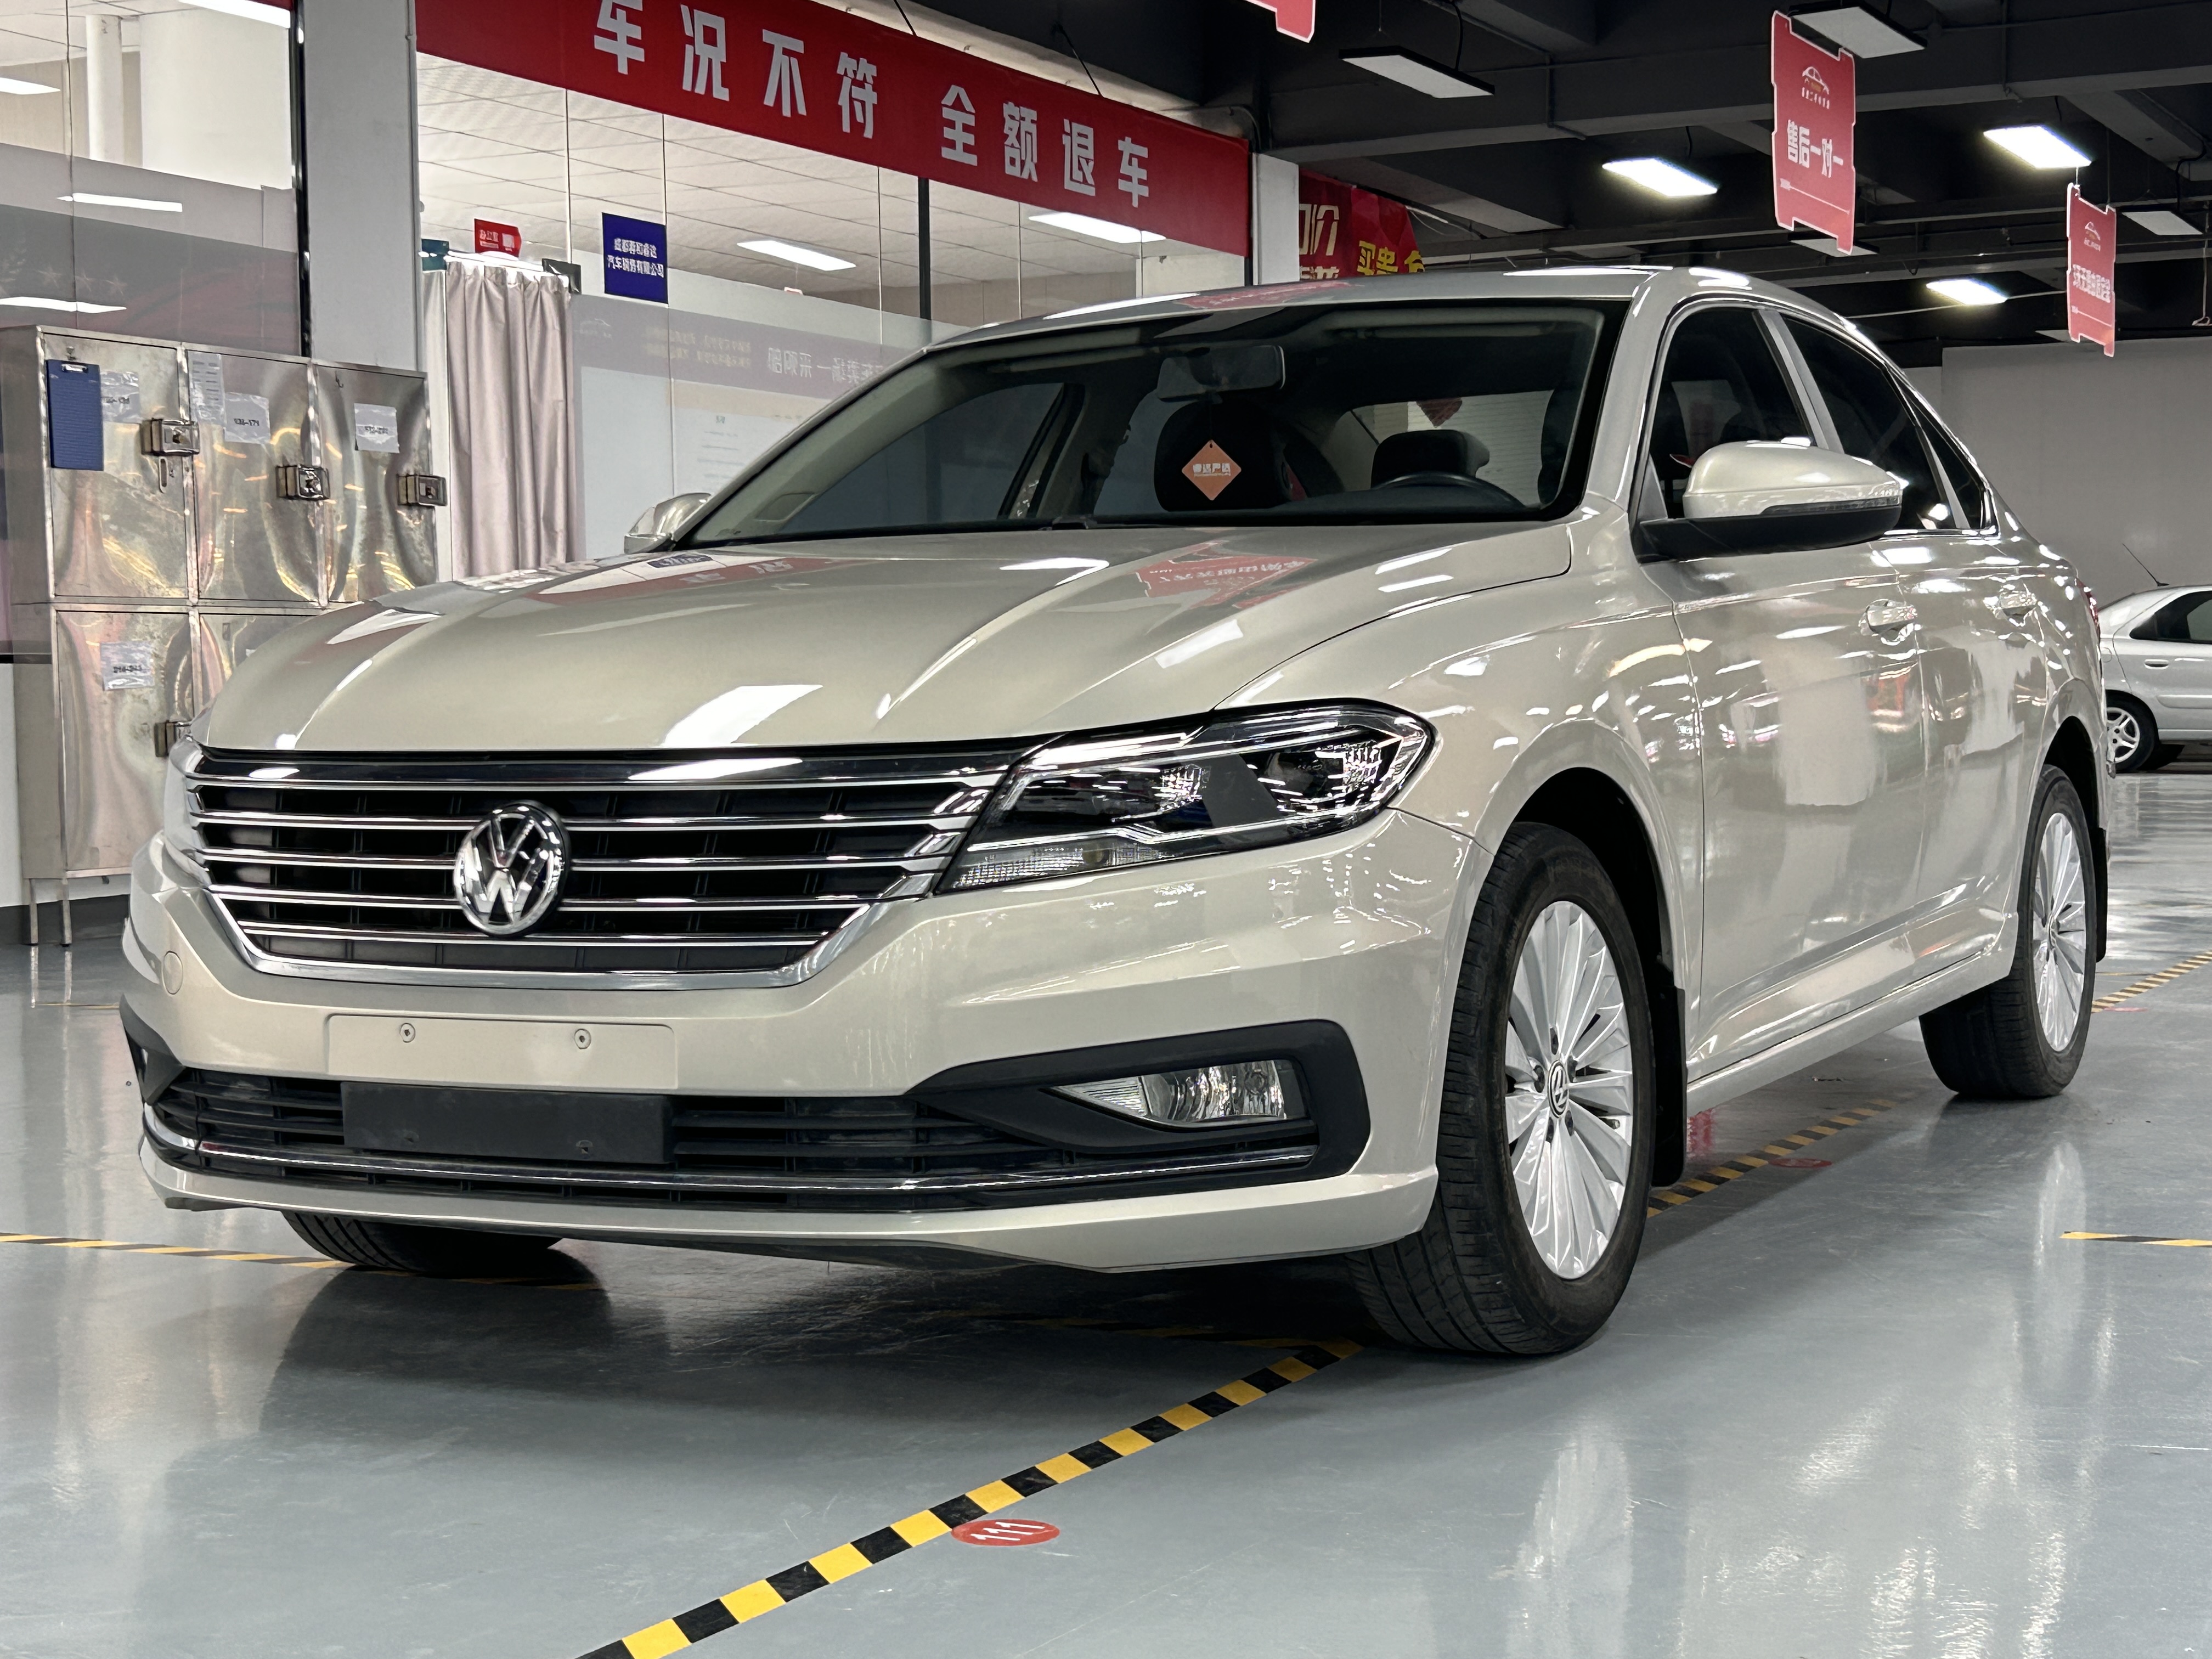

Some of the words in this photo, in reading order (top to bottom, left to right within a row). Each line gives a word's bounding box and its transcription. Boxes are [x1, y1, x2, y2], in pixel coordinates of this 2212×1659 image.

[594, 0, 877, 139] 车况不符
[941, 84, 1149, 208] 全额退车
[1787, 120, 1844, 178] 售后一对一
